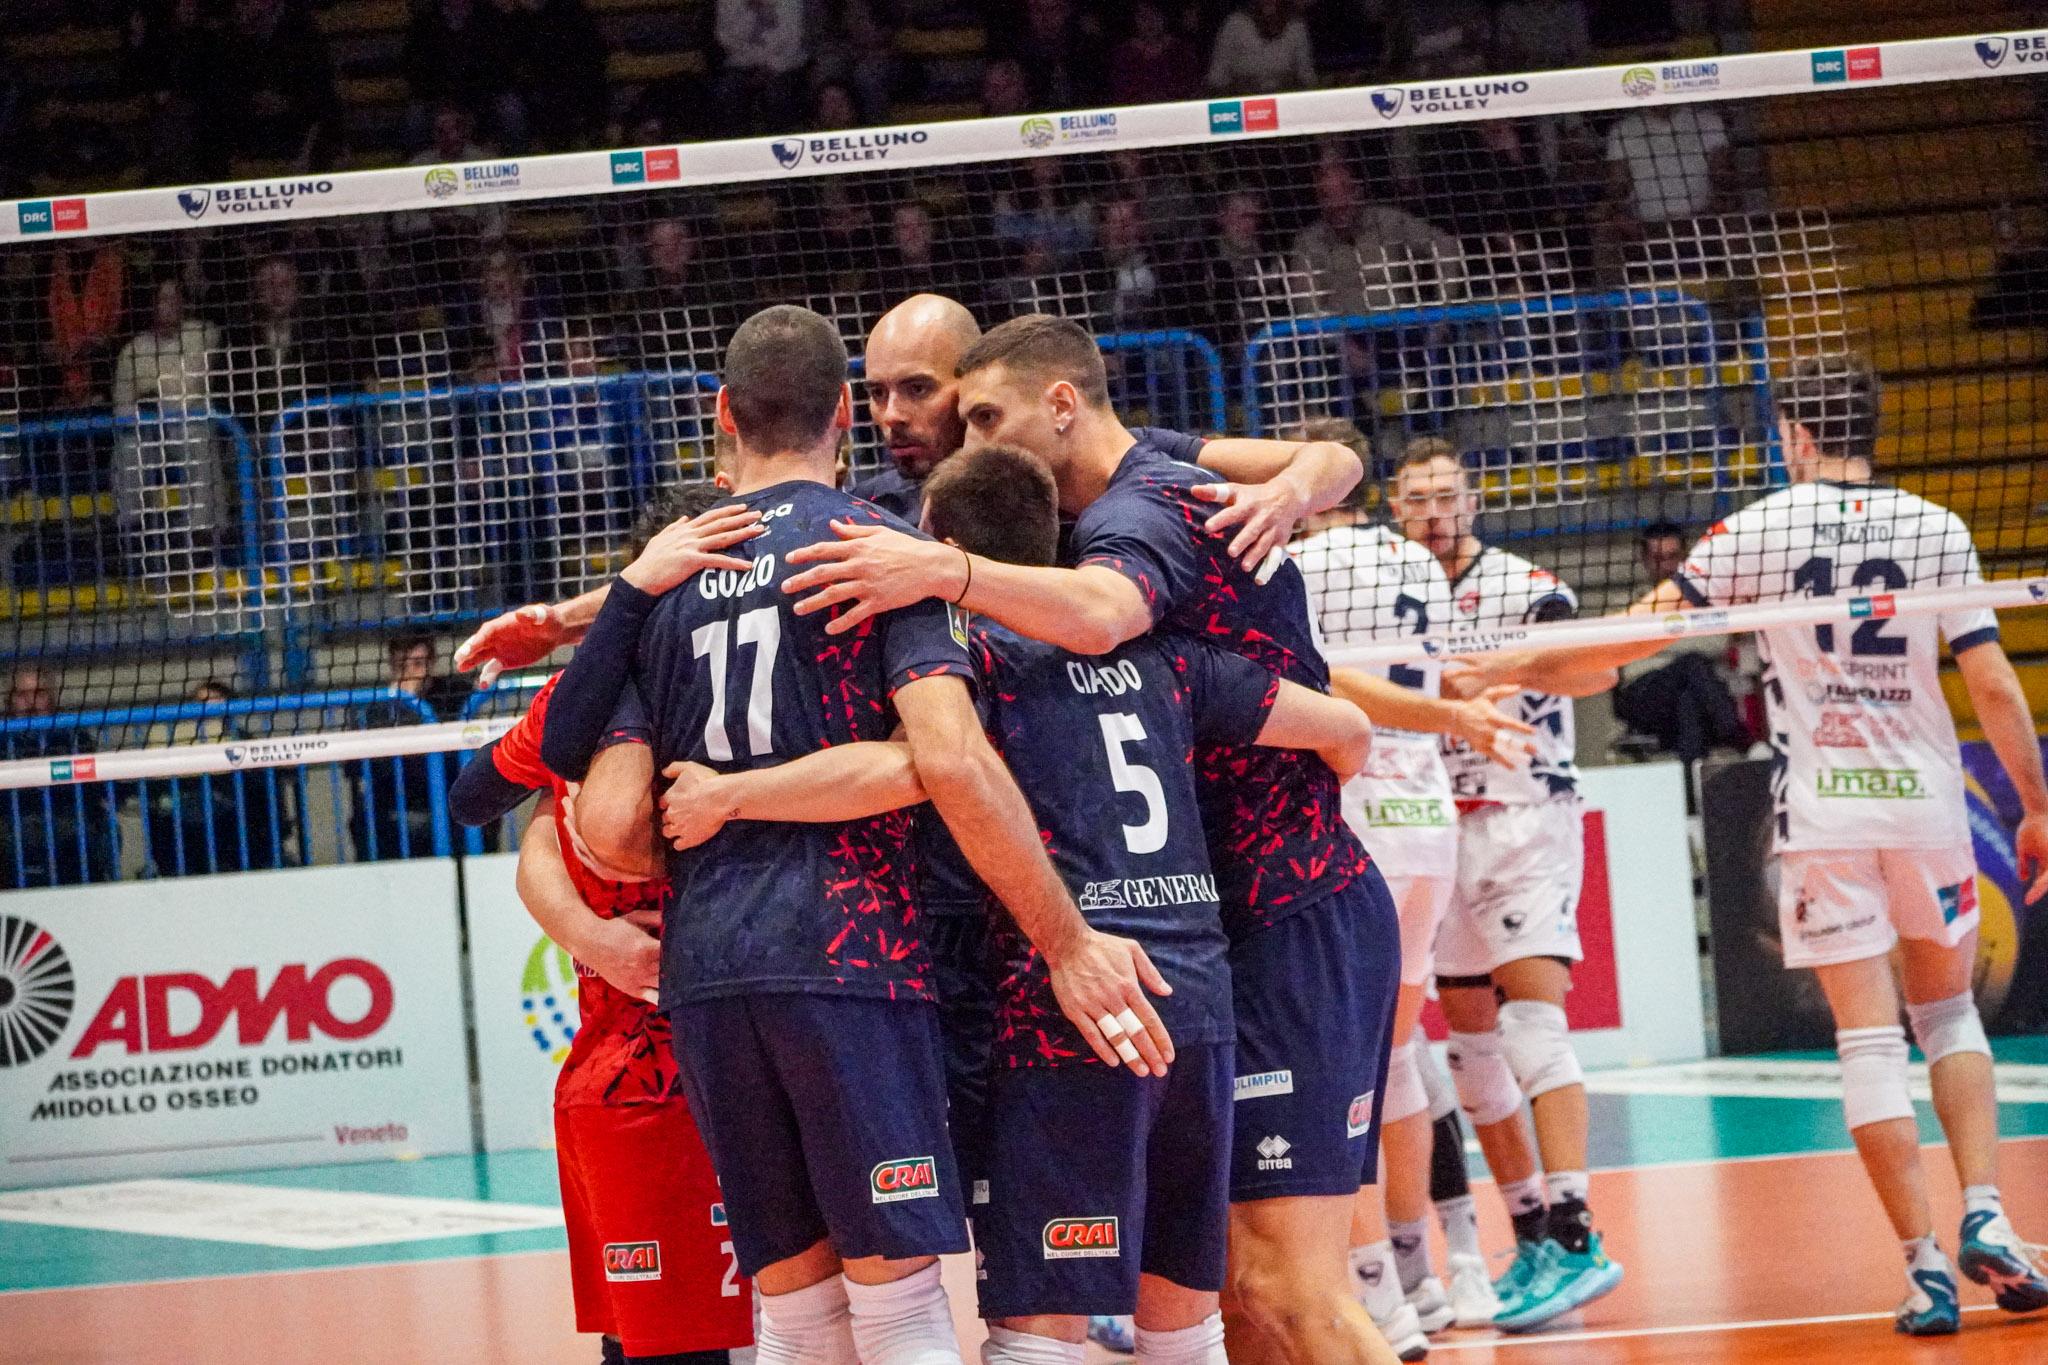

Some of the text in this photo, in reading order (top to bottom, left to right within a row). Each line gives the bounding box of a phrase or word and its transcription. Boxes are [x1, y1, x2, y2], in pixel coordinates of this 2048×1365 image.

[1662, 63, 1719, 80] BELLUNO
[1816, 61, 1842, 73] DRC
[1410, 81, 1529, 102] BELLUNO
[1411, 99, 1488, 113] VOLLEY
[1061, 113, 1117, 130] BELLUNO
[810, 131, 928, 152] BELLUNO
[812, 149, 889, 164] VOLLEY
[464, 163, 520, 181] BELLUNO
[615, 162, 640, 174] DRC
[216, 181, 333, 202] BELLUNO
[218, 198, 293, 213] VOLLEY
[23, 211, 48, 223] DRC
[1794, 556, 1908, 656] 12
[1447, 631, 1527, 645] BELLUNO
[1449, 643, 1500, 654] VOLLEY
[691, 605, 781, 761] 17
[1066, 658, 1143, 697] CIADO
[250, 740, 328, 755] BELLUNO
[251, 752, 301, 762] VOLLEY
[1098, 711, 1169, 854] 5
[69, 957, 395, 1060] ADMO
[48, 1048, 404, 1093] ASSOCIAZIONE DONATORI
[30, 1087, 259, 1121] MIDOLLO OSSEO
[334, 1122, 408, 1145] Veneto
[1257, 1158, 1293, 1170] errea
[877, 1162, 932, 1190] CRAI
[1049, 1222, 1114, 1247] CRAI
[606, 1247, 656, 1271] CRAI
